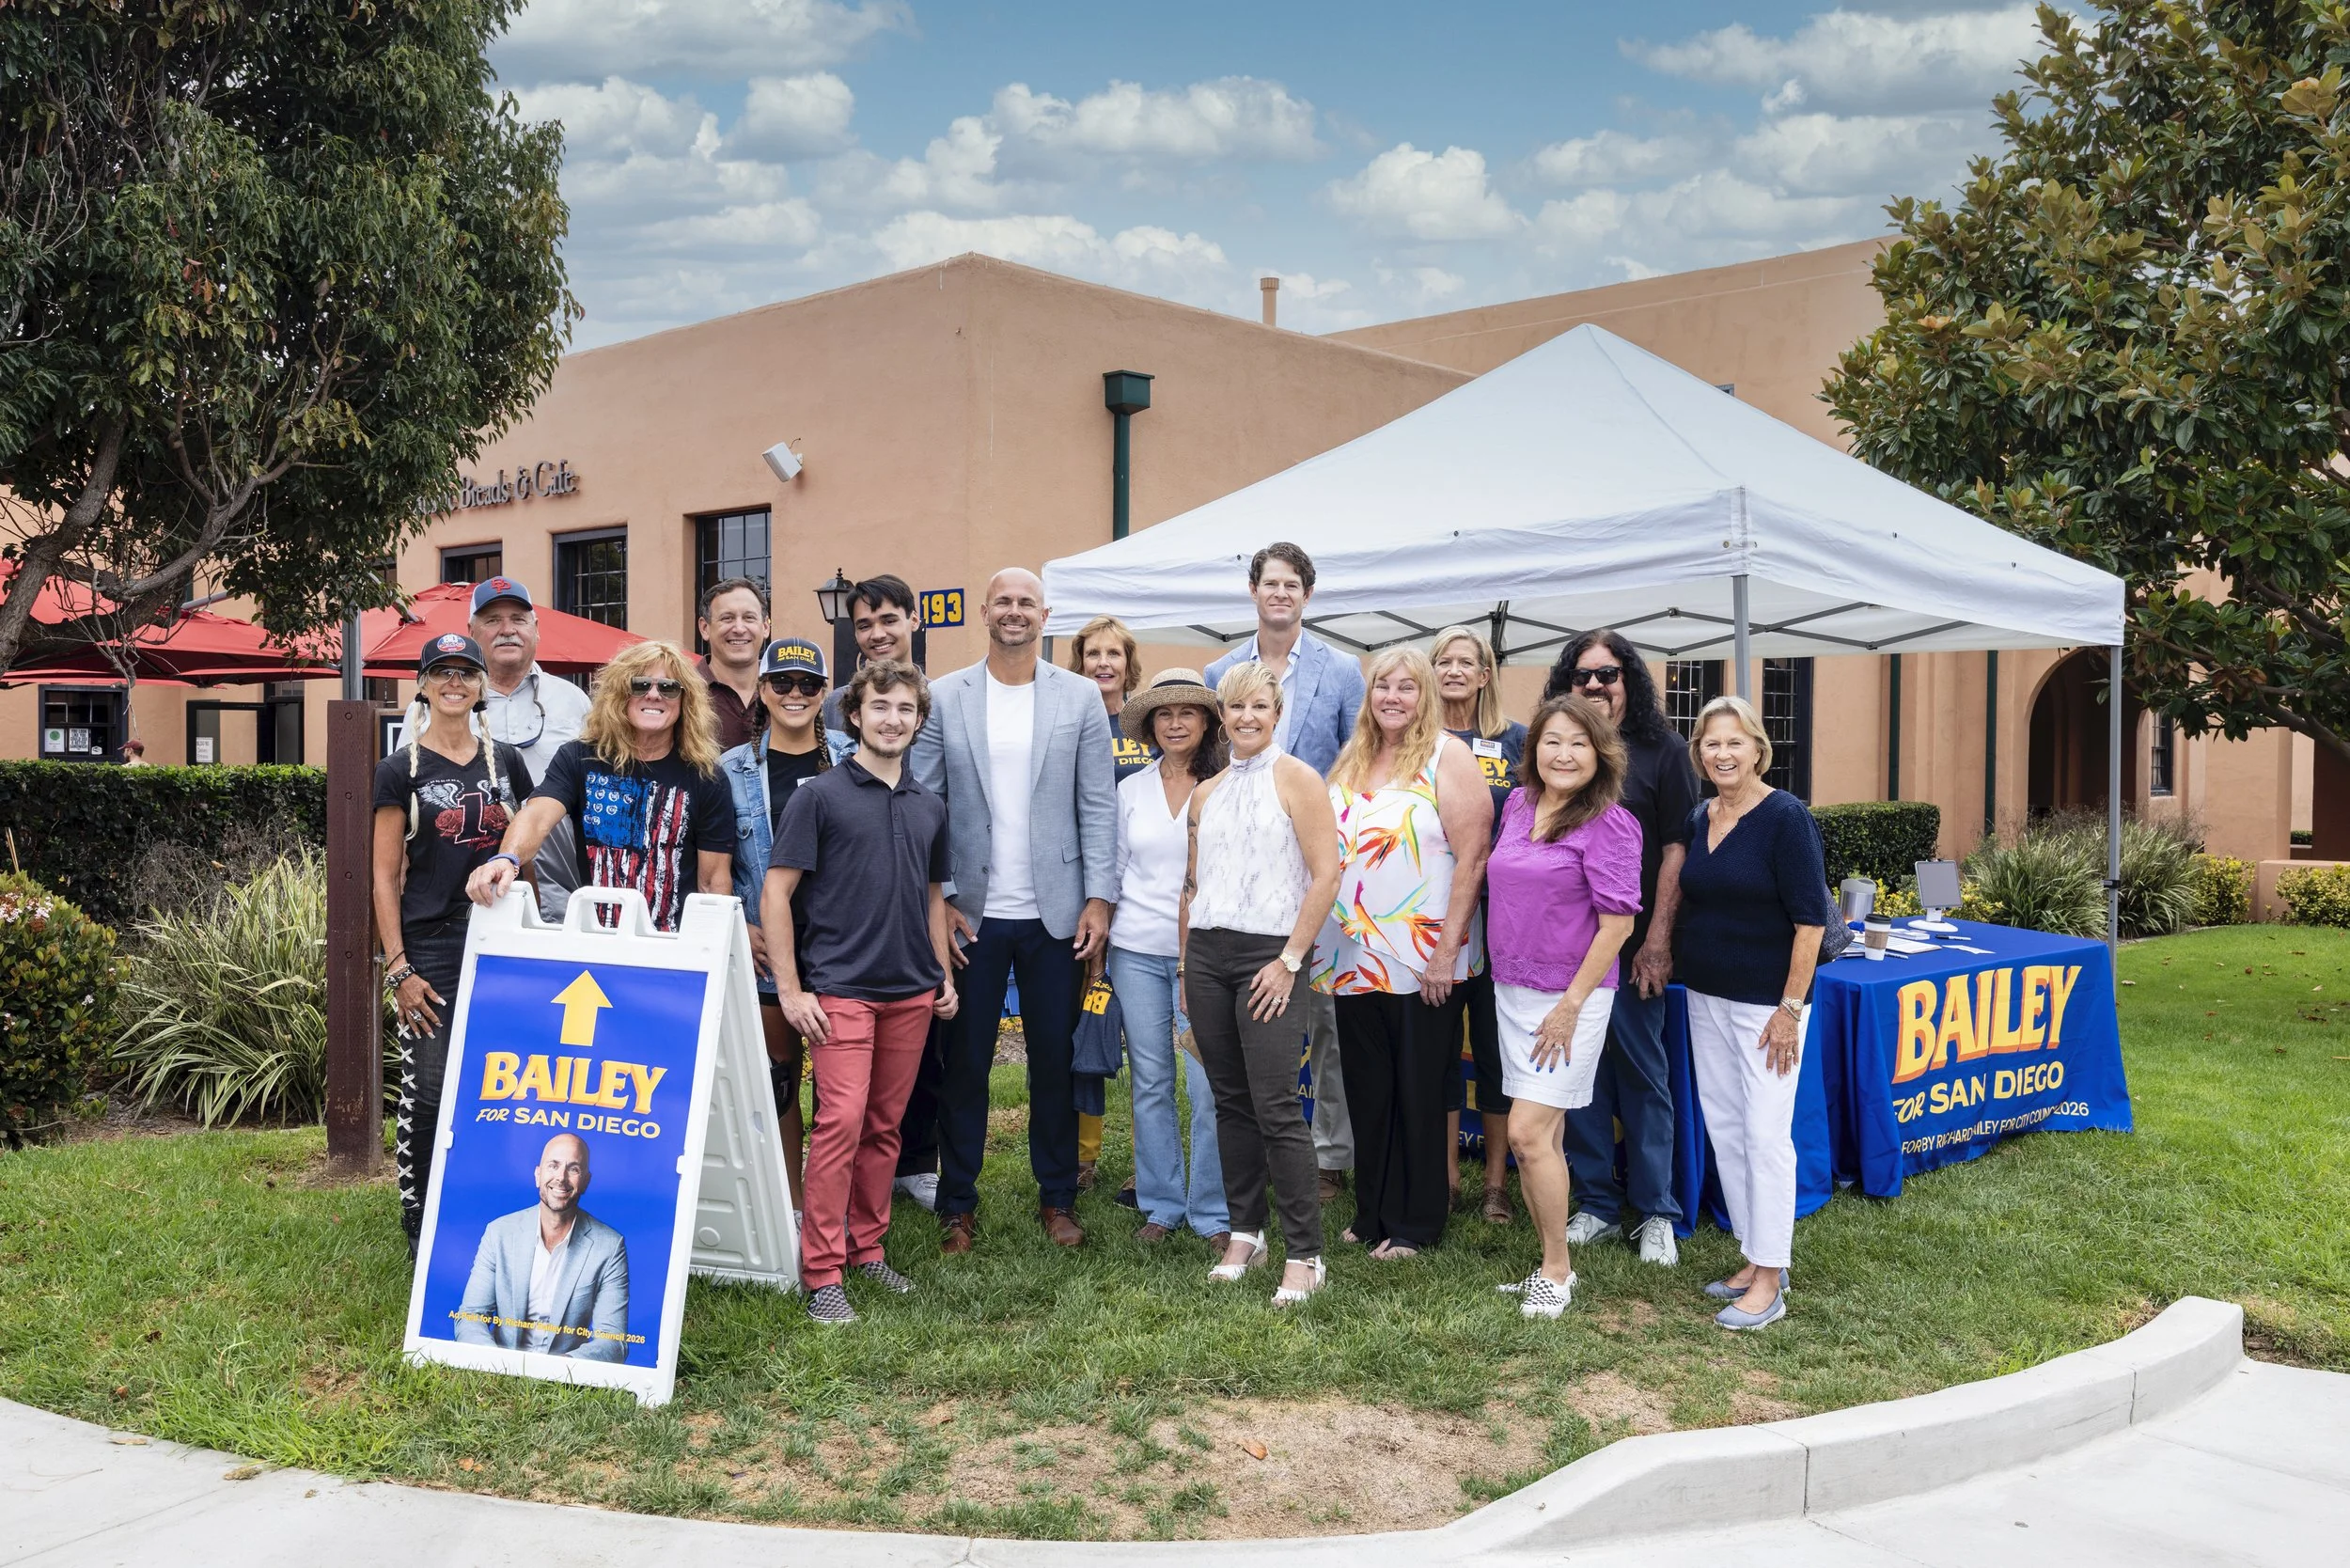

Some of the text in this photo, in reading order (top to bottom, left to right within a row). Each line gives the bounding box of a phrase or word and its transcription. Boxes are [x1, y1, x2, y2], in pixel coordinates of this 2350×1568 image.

[460, 469, 510, 509] Breads
[514, 465, 532, 499] &
[922, 592, 962, 624] 193
[777, 646, 816, 660] BAILEY
[1486, 778, 1511, 788] EGO
[455, 792, 487, 844] 1
[1891, 965, 2082, 1084] BAILEY
[479, 1051, 667, 1115] BAILEY
[1930, 1074, 1986, 1114] SAN
[1993, 1060, 2064, 1099] DIEGO
[476, 1107, 661, 1139] FOR SAN DIEGO
[480, 1314, 491, 1324] for
[493, 1316, 503, 1326] By
[505, 1318, 535, 1329] Richard
[537, 1322, 561, 1334] Bailey
[563, 1325, 575, 1334] for
[576, 1327, 592, 1339] City
[594, 1329, 624, 1341] Council
[626, 1334, 646, 1344] 2026
